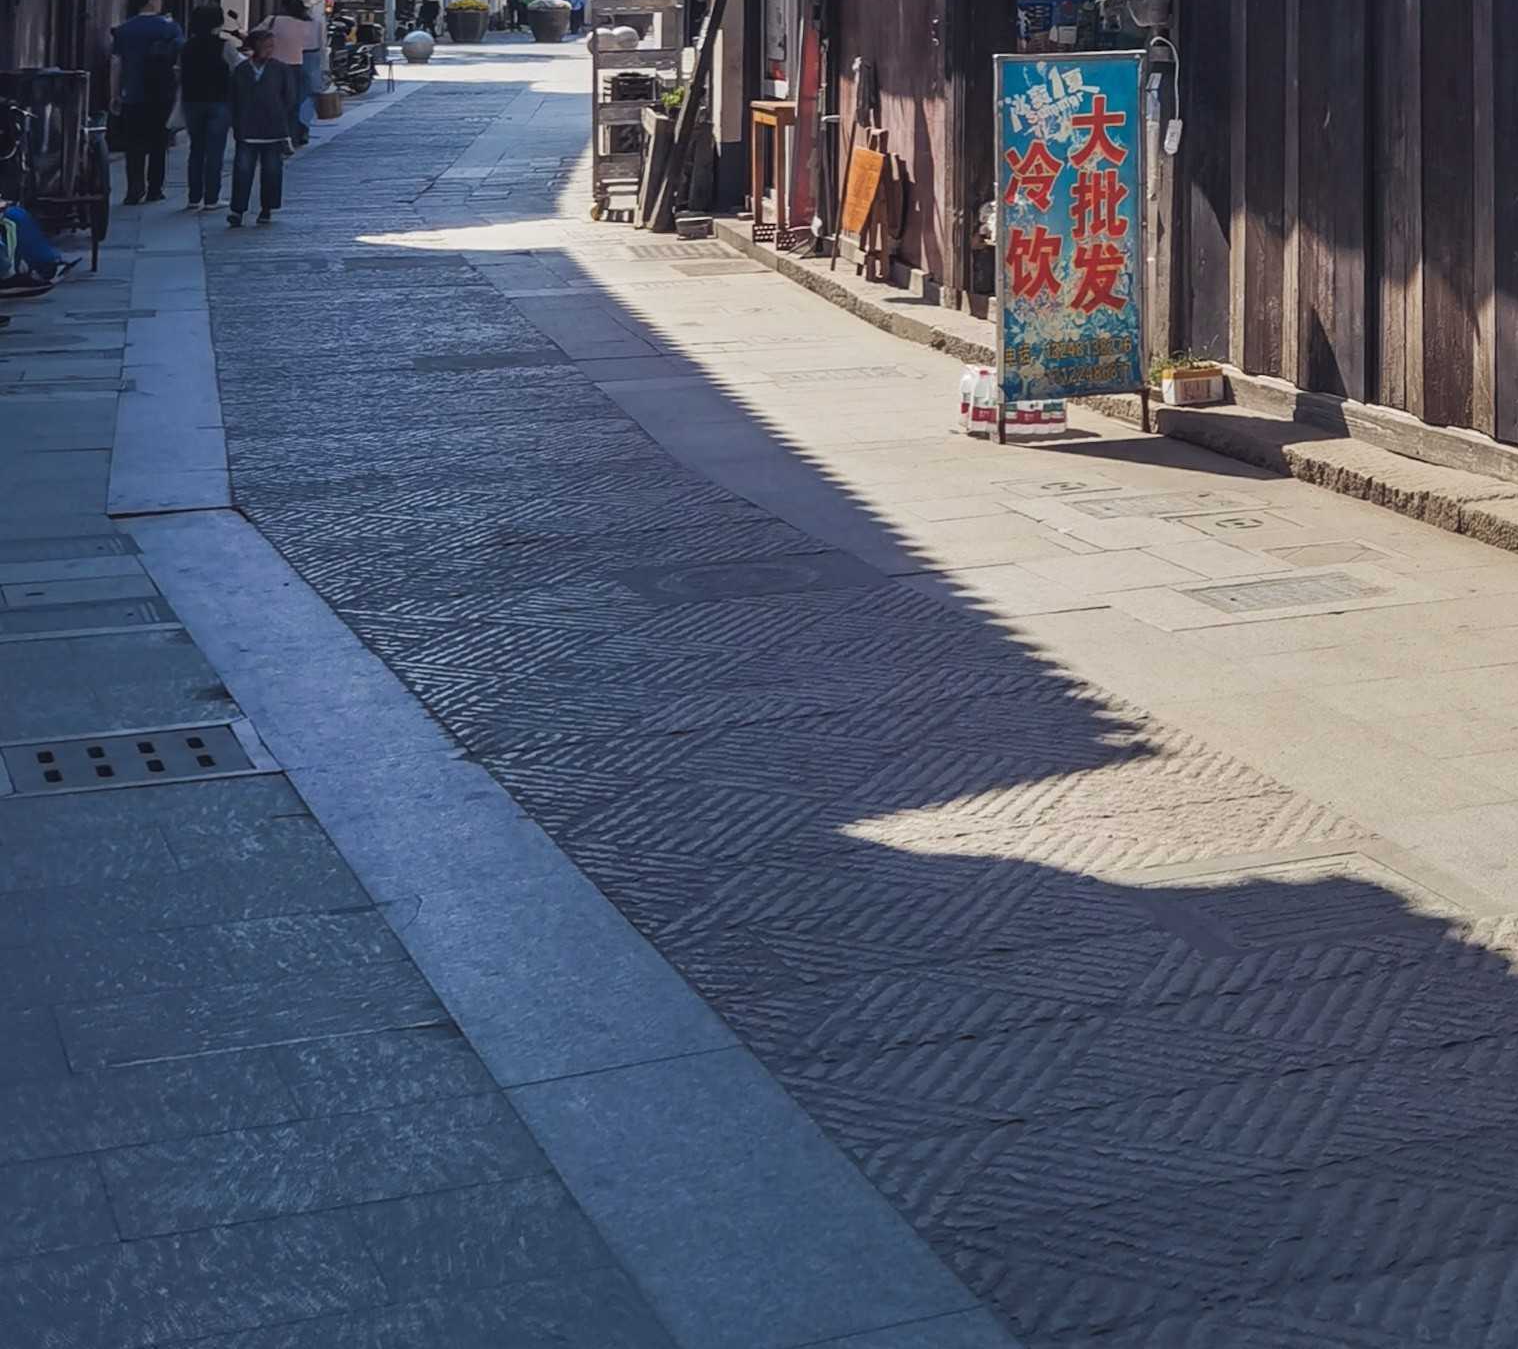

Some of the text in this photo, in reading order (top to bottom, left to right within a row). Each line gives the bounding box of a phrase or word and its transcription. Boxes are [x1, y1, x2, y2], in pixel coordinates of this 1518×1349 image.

[1004, 139, 1064, 304] 冷饮
[1069, 94, 1129, 315] 大批发
